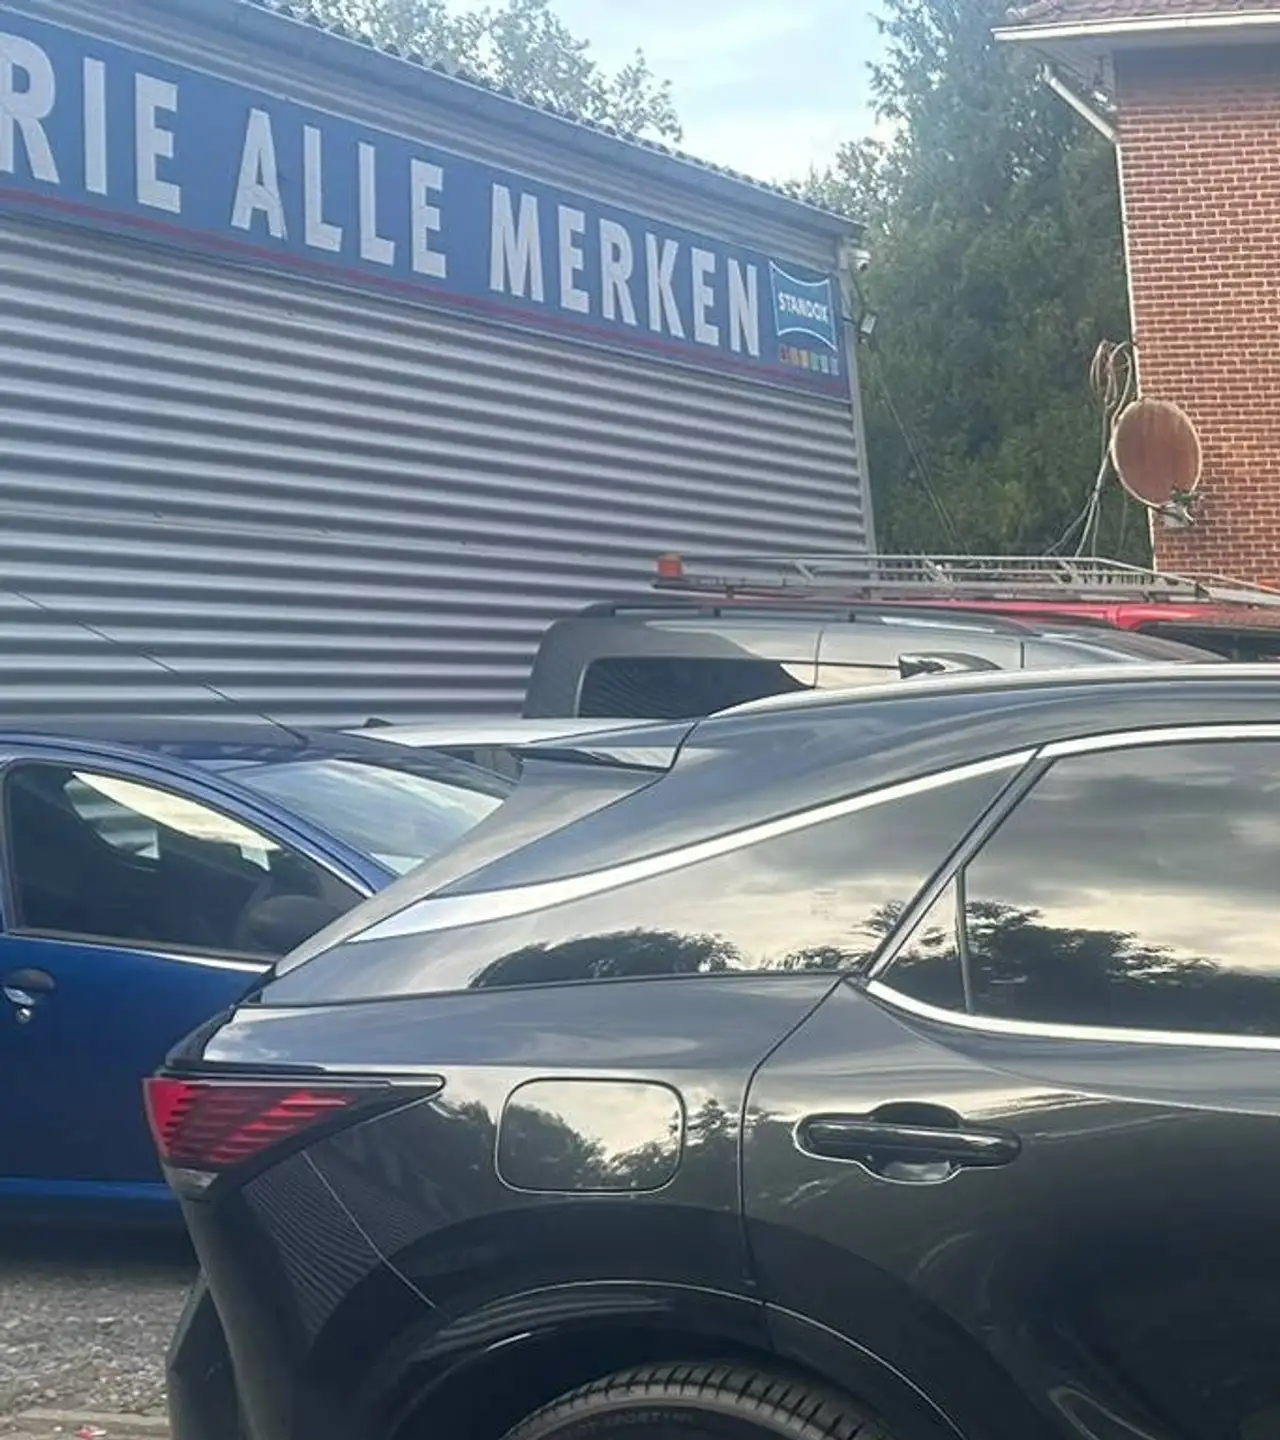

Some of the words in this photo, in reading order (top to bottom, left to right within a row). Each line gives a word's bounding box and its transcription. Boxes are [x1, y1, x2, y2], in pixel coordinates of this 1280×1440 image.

[0, 32, 181, 213] RIE
[230, 108, 446, 278] ALLE
[489, 182, 759, 357] MERKEN
